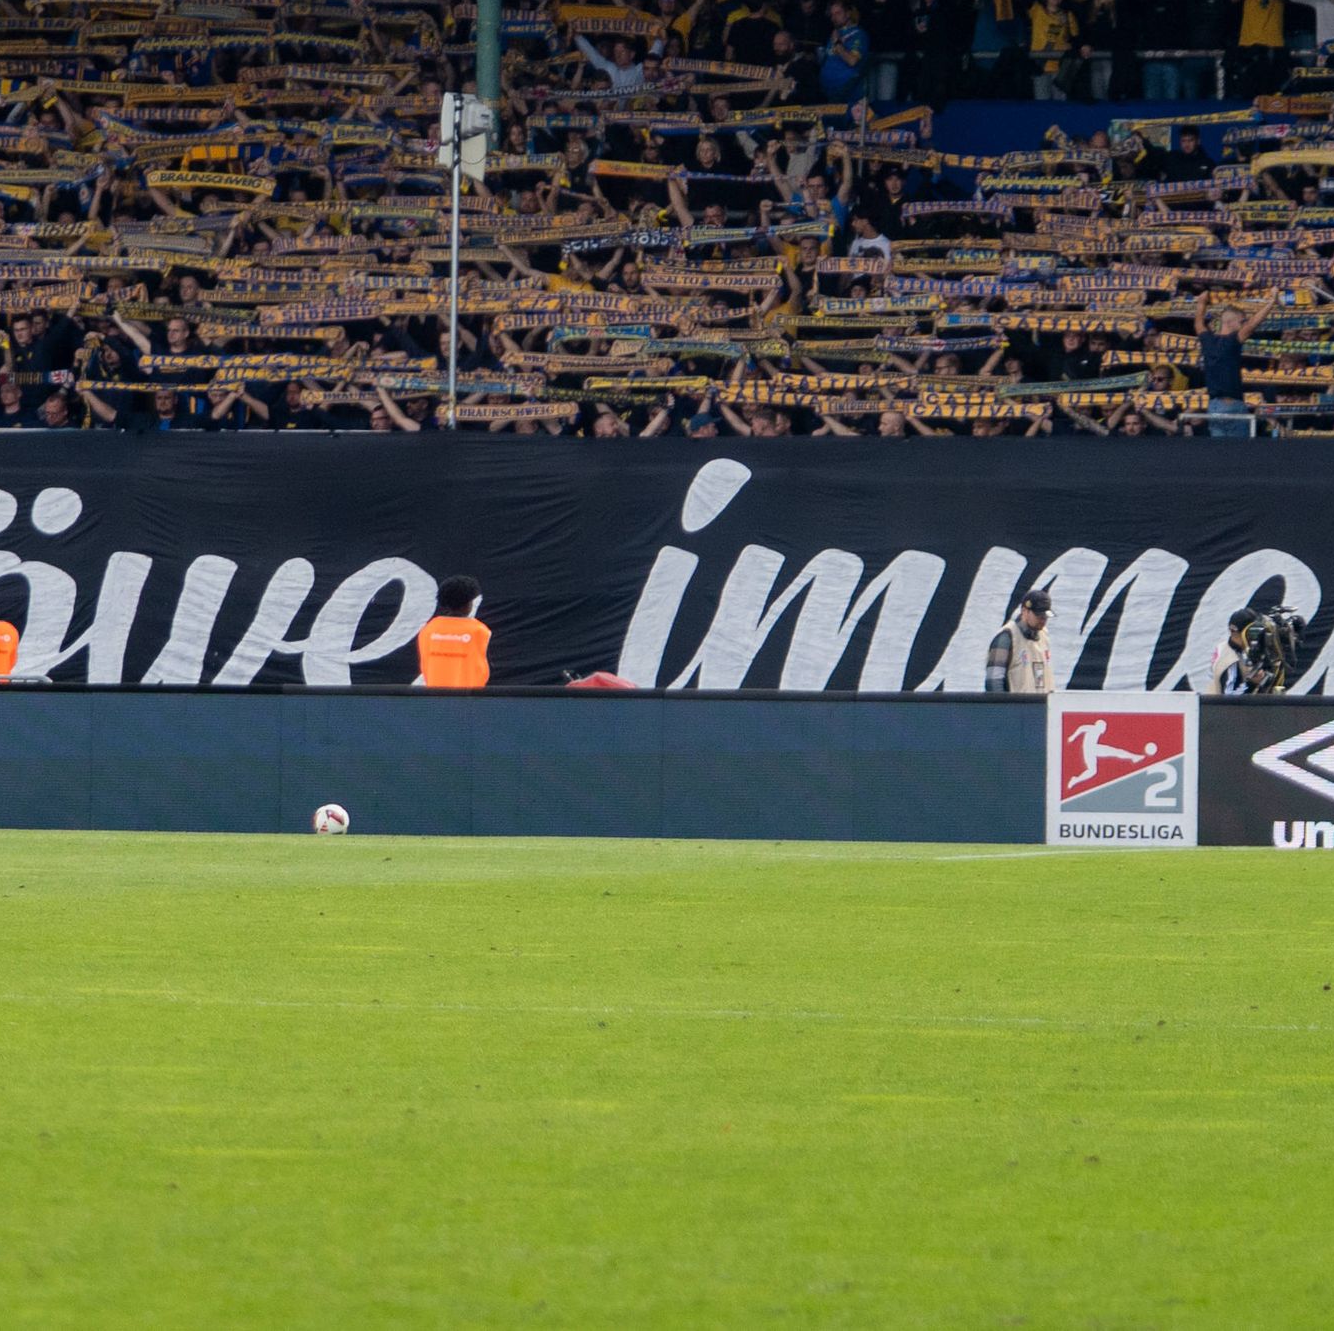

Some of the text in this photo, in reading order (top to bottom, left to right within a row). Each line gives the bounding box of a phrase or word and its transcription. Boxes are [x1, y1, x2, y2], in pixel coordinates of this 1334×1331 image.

[159, 172, 263, 188] BRAUNSCHWEIG
[641, 274, 779, 287] ASSALTO COMANDO
[459, 404, 555, 418] BRAUNSCHWEIG
[1144, 768, 1178, 808] 2
[1059, 823, 1184, 841] BUNDESLIGA
